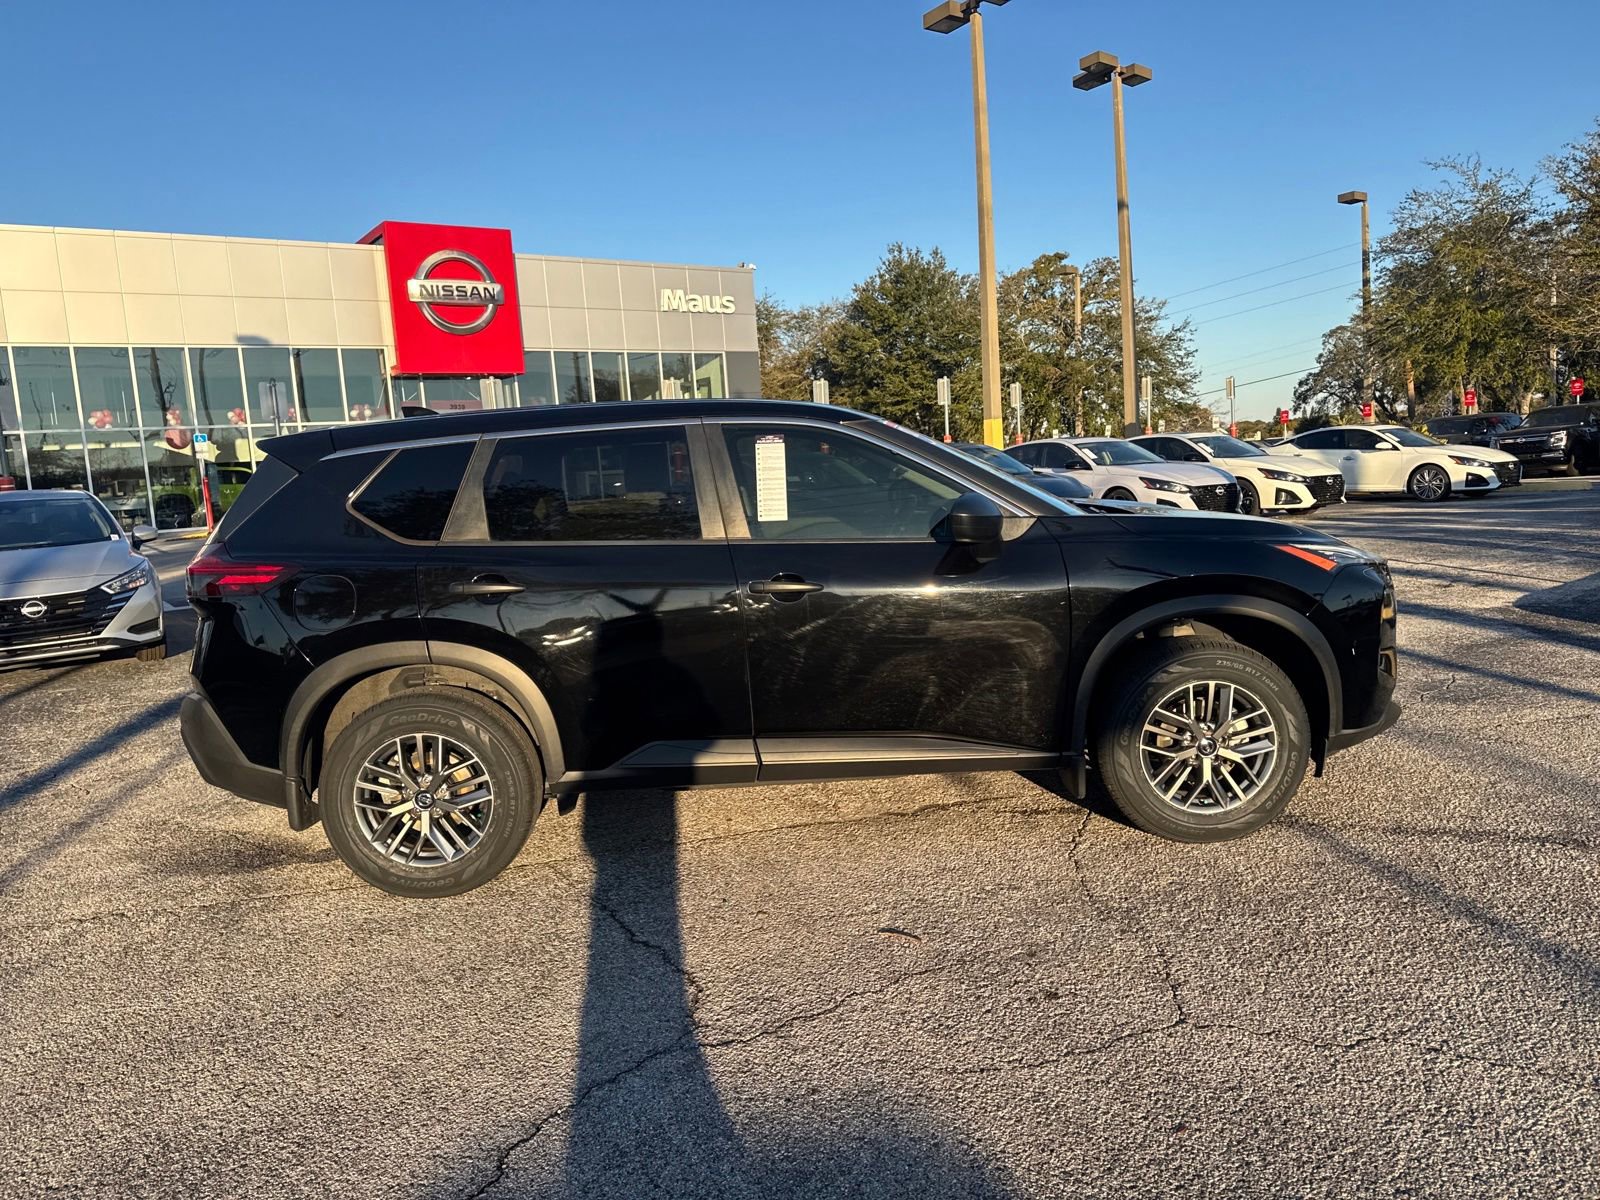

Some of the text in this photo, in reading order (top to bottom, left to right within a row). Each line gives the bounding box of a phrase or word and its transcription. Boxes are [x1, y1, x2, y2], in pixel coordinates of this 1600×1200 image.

[420, 284, 496, 299] NISSAN
[660, 288, 736, 314] Maus
[1245, 666, 1261, 677] R17
[389, 712, 458, 727] GeoDrive
[1265, 751, 1299, 809] GeoDrive
